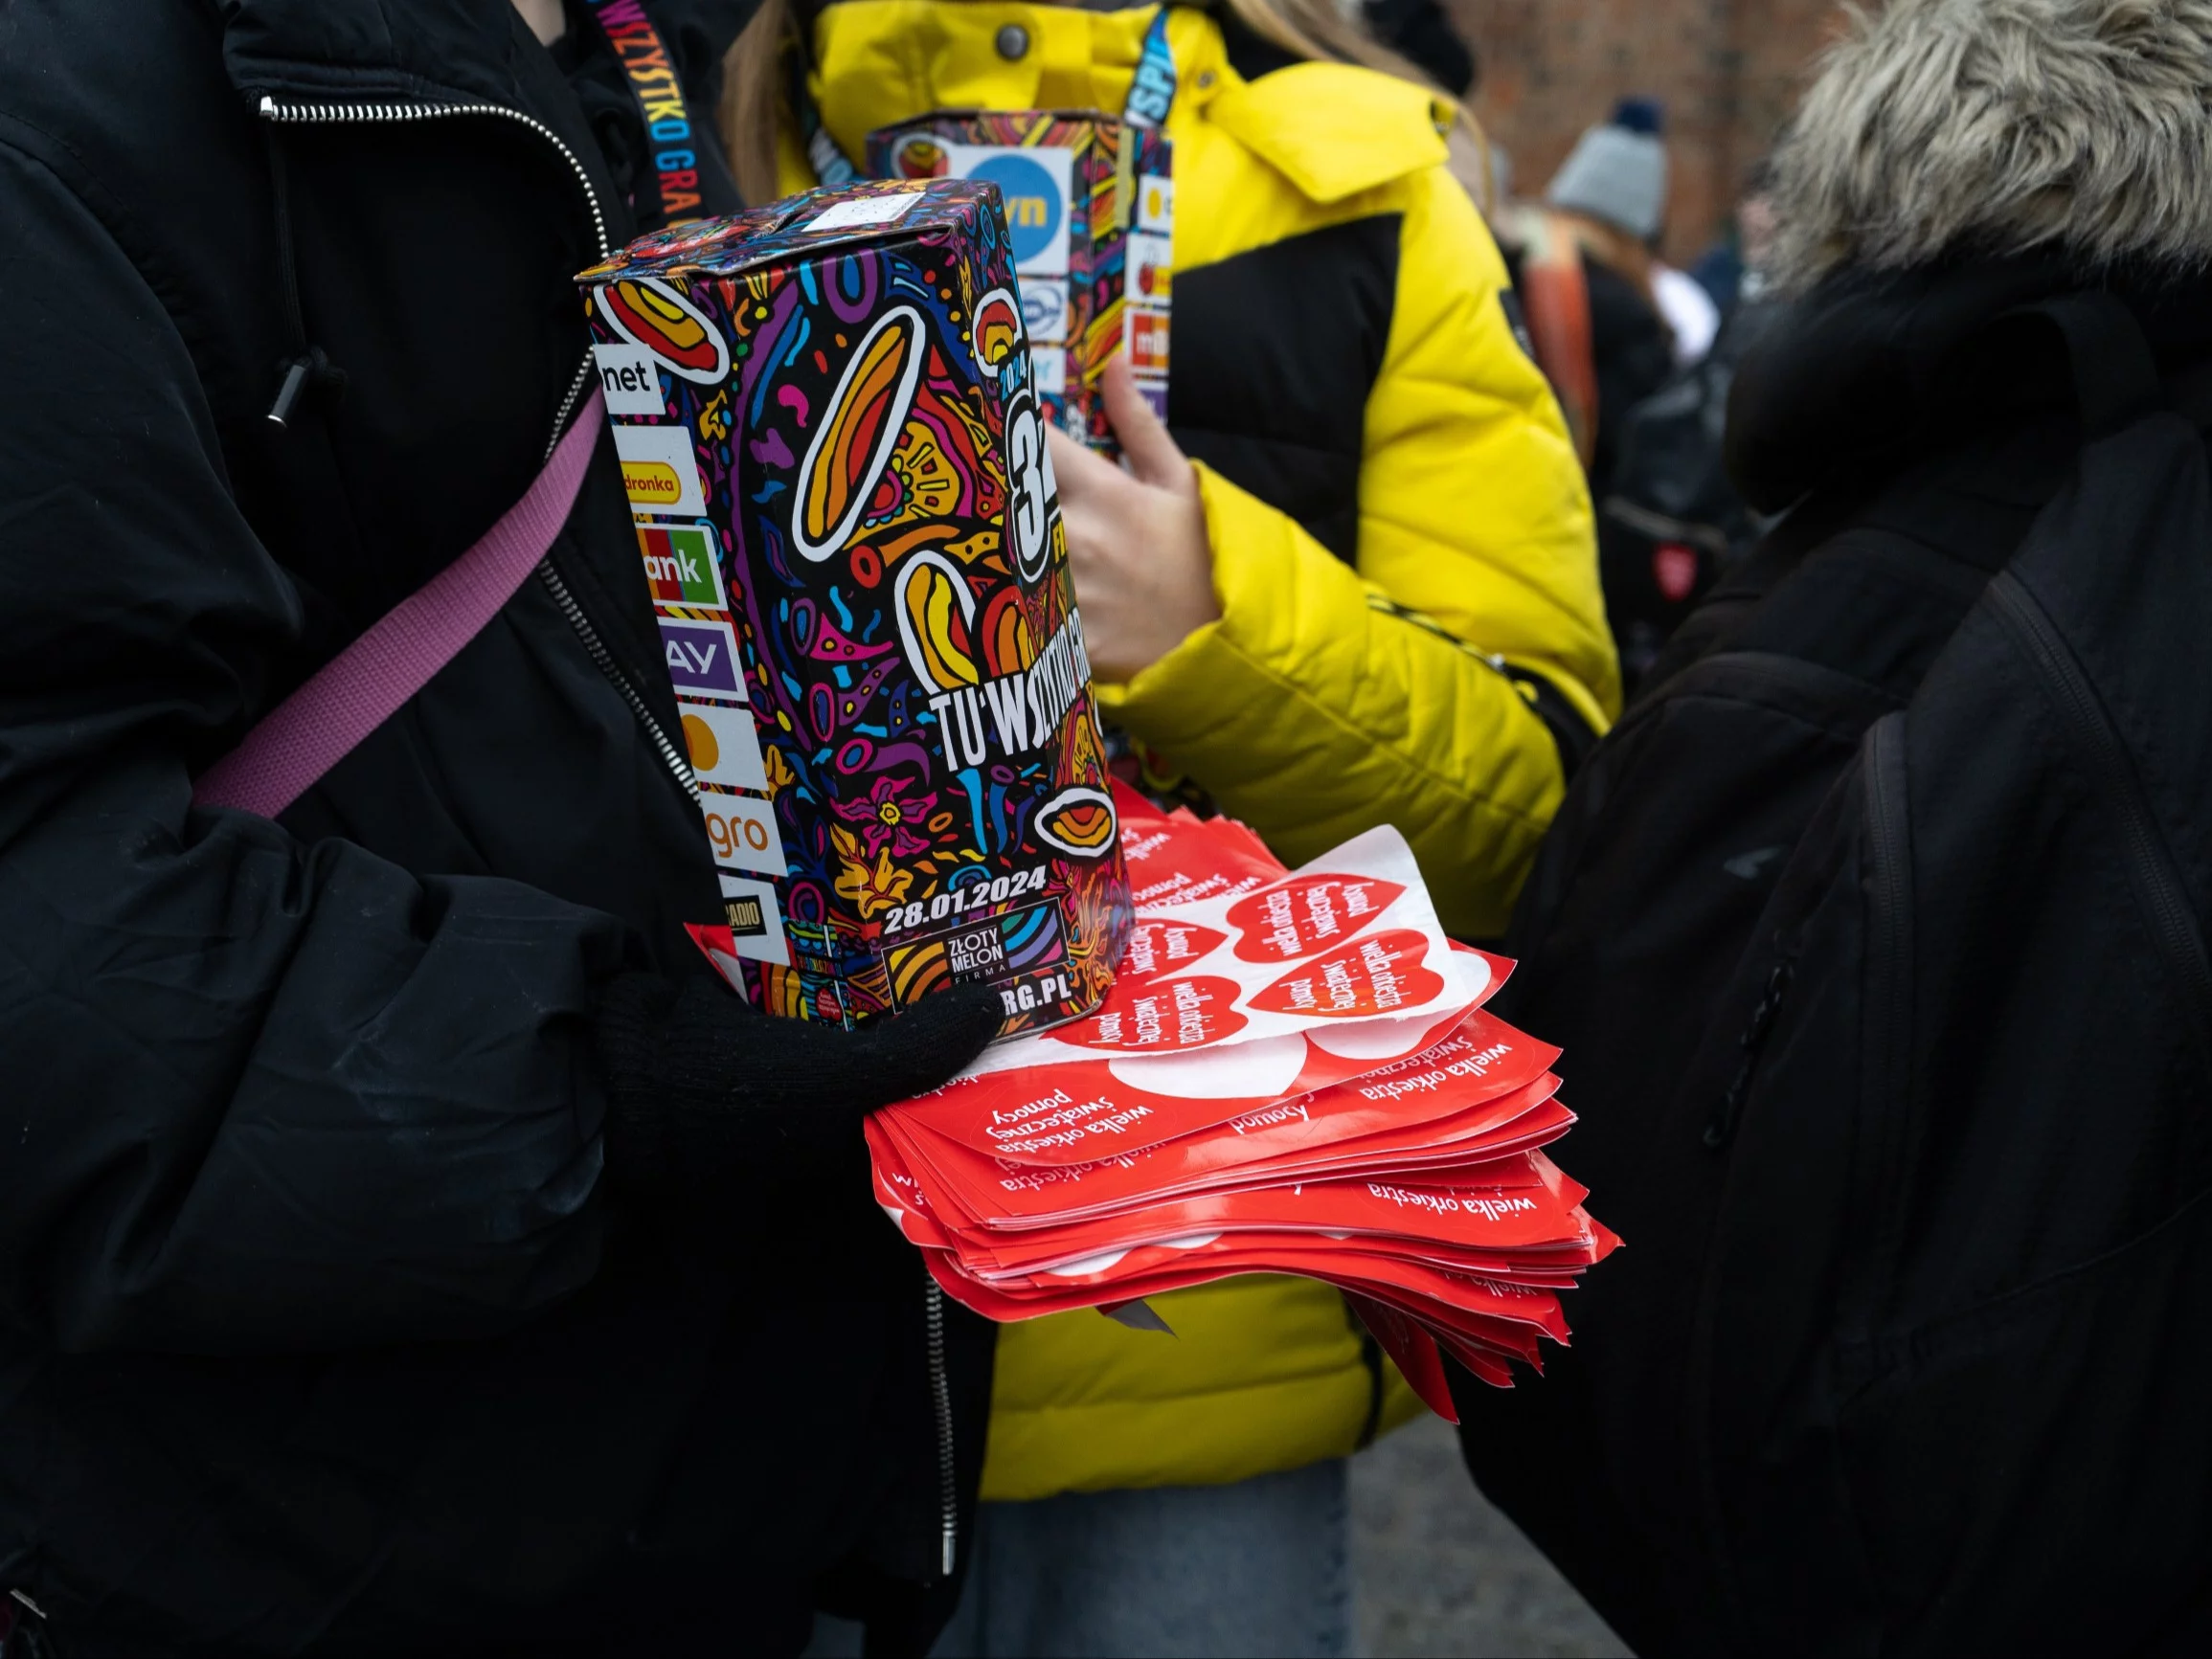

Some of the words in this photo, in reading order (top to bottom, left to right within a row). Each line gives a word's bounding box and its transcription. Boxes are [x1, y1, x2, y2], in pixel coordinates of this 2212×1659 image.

[596, 0, 690, 142] WSZYSTKO
[655, 148, 701, 213] GRA
[1000, 349, 1027, 402] 2024
[929, 686, 986, 772] TU
[884, 865, 1047, 934] 28.01.2024
[1340, 882, 1380, 918] pomocy
[948, 929, 998, 957] ZŁOTY
[1261, 926, 1303, 956] wielka
[1360, 939, 1402, 975] wielka
[952, 945, 1004, 974] MELON
[955, 966, 1006, 984] FIRMA
[1173, 981, 1214, 1012] wielka
[1279, 977, 1318, 1011] pomocy
[1371, 973, 1411, 1009] orkiestra
[1089, 1012, 1123, 1043] pomocy
[1178, 1009, 1216, 1044] orkiestra
[1445, 1042, 1513, 1078] wielka
[1360, 1069, 1447, 1100] orkiestra
[985, 1096, 1117, 1142] świątecznej
[992, 1088, 1073, 1125] pomocy
[1084, 1105, 1154, 1135] wielka
[1229, 1104, 1310, 1135] pomocy
[995, 1129, 1086, 1155] orkiestra
[1367, 1182, 1459, 1216] orkiestra
[1462, 1196, 1537, 1222] wielka
